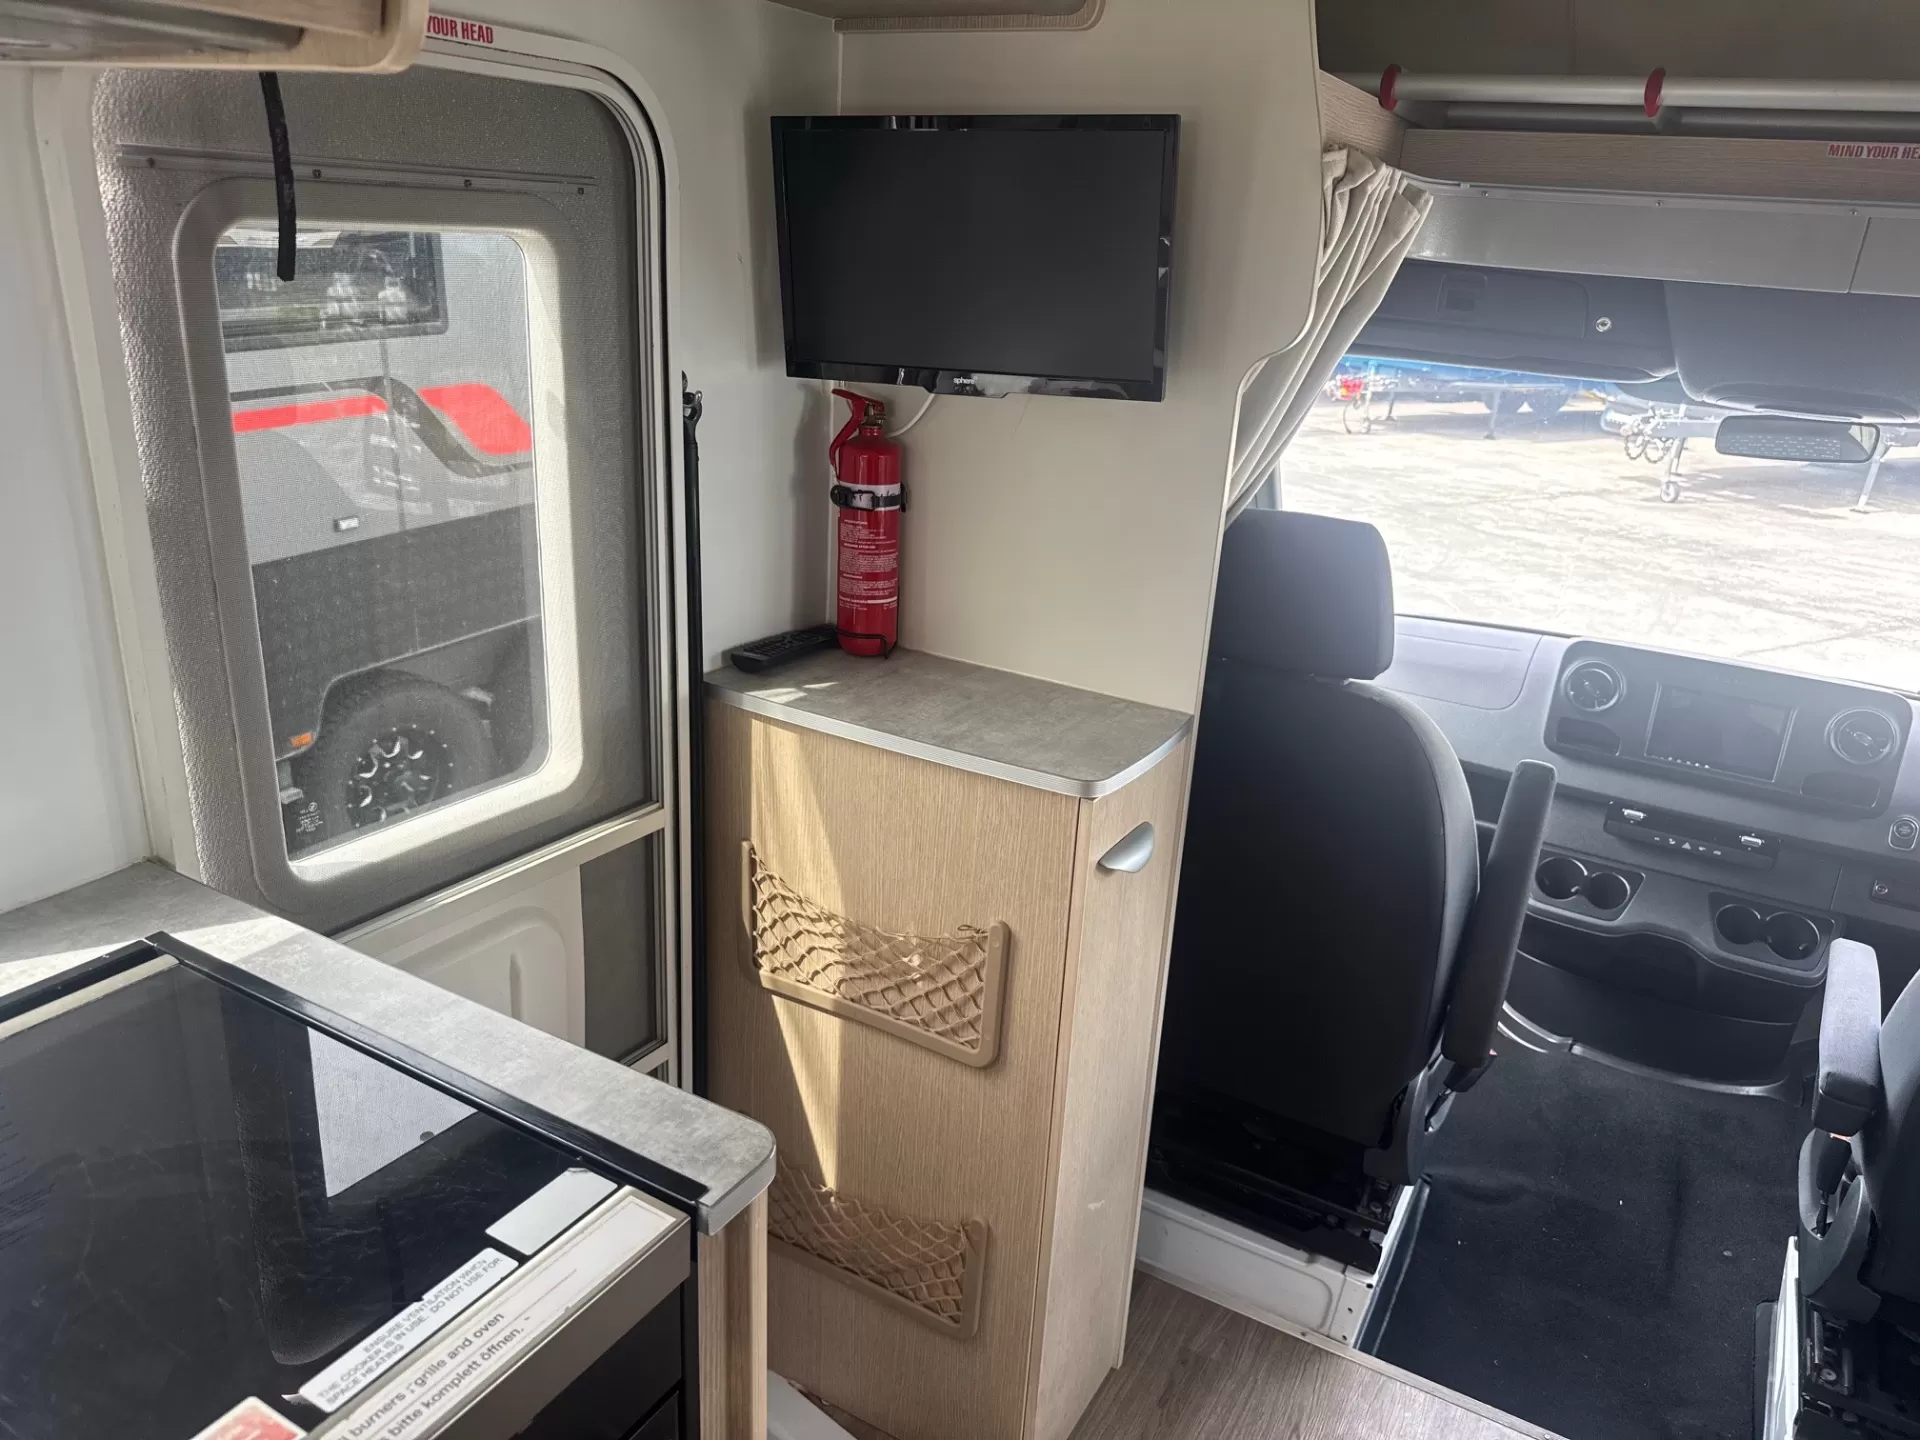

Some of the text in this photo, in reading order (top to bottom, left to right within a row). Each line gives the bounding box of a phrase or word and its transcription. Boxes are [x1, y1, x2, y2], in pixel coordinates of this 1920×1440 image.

[460, 21, 493, 44] HEAD
[1827, 144, 1864, 158] MIND
[1866, 145, 1899, 159] YOUR
[316, 1381, 340, 1398] THE
[340, 1348, 382, 1382] COOKER
[382, 1338, 395, 1350] IS
[393, 1330, 406, 1342] IN
[429, 1300, 446, 1314] DO
[444, 1284, 464, 1302] NOT
[463, 1271, 484, 1287] USE
[482, 1257, 503, 1273] FOR
[363, 1321, 404, 1353] ENSURE
[402, 1278, 460, 1322] VENTILATION
[447, 1336, 473, 1360] and
[473, 1312, 505, 1339] oven
[325, 1343, 404, 1404] SPACE HEATING
[388, 1407, 424, 1437] bitte
[421, 1359, 482, 1410] komplett
